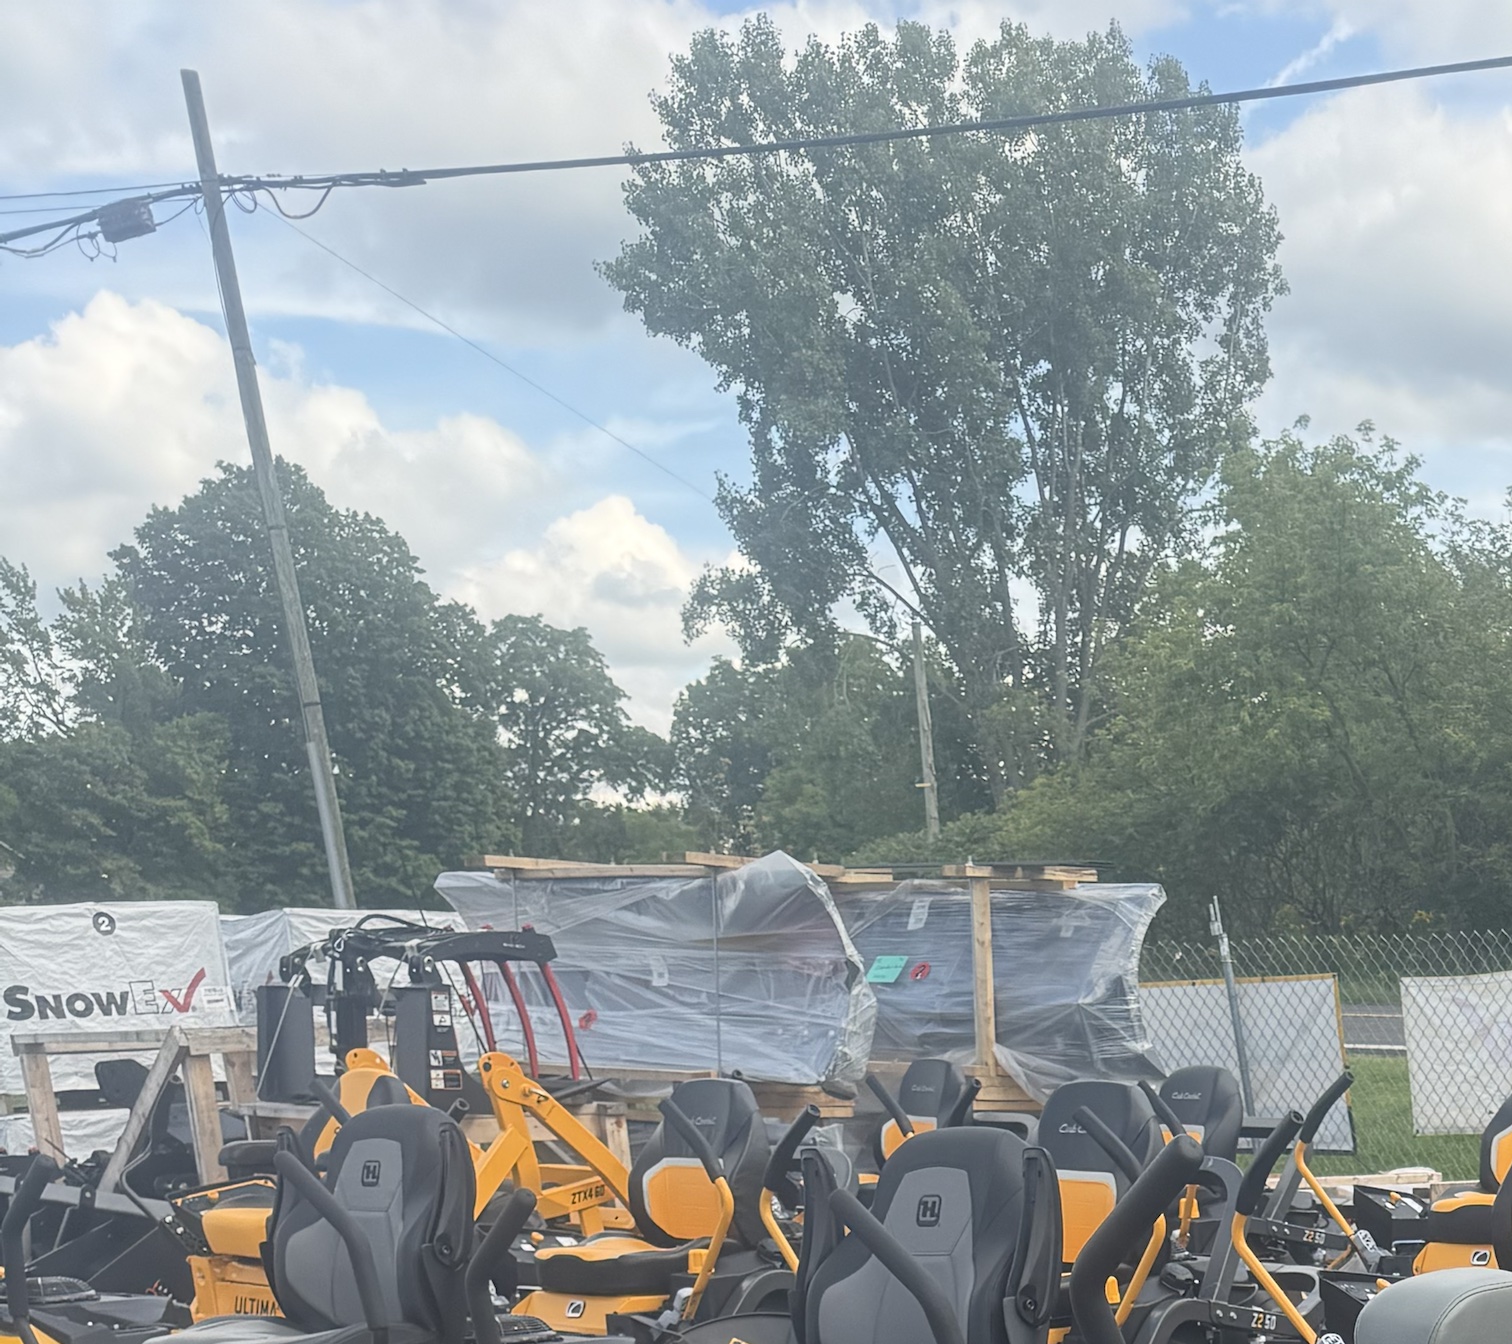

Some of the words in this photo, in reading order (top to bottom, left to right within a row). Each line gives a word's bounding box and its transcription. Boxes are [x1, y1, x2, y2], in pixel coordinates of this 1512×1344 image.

[98, 916, 111, 930] 2
[235, 1295, 276, 1315] ULTIMA
[1251, 1313, 1264, 1328] Z2
[1264, 1314, 1277, 1330] 50
